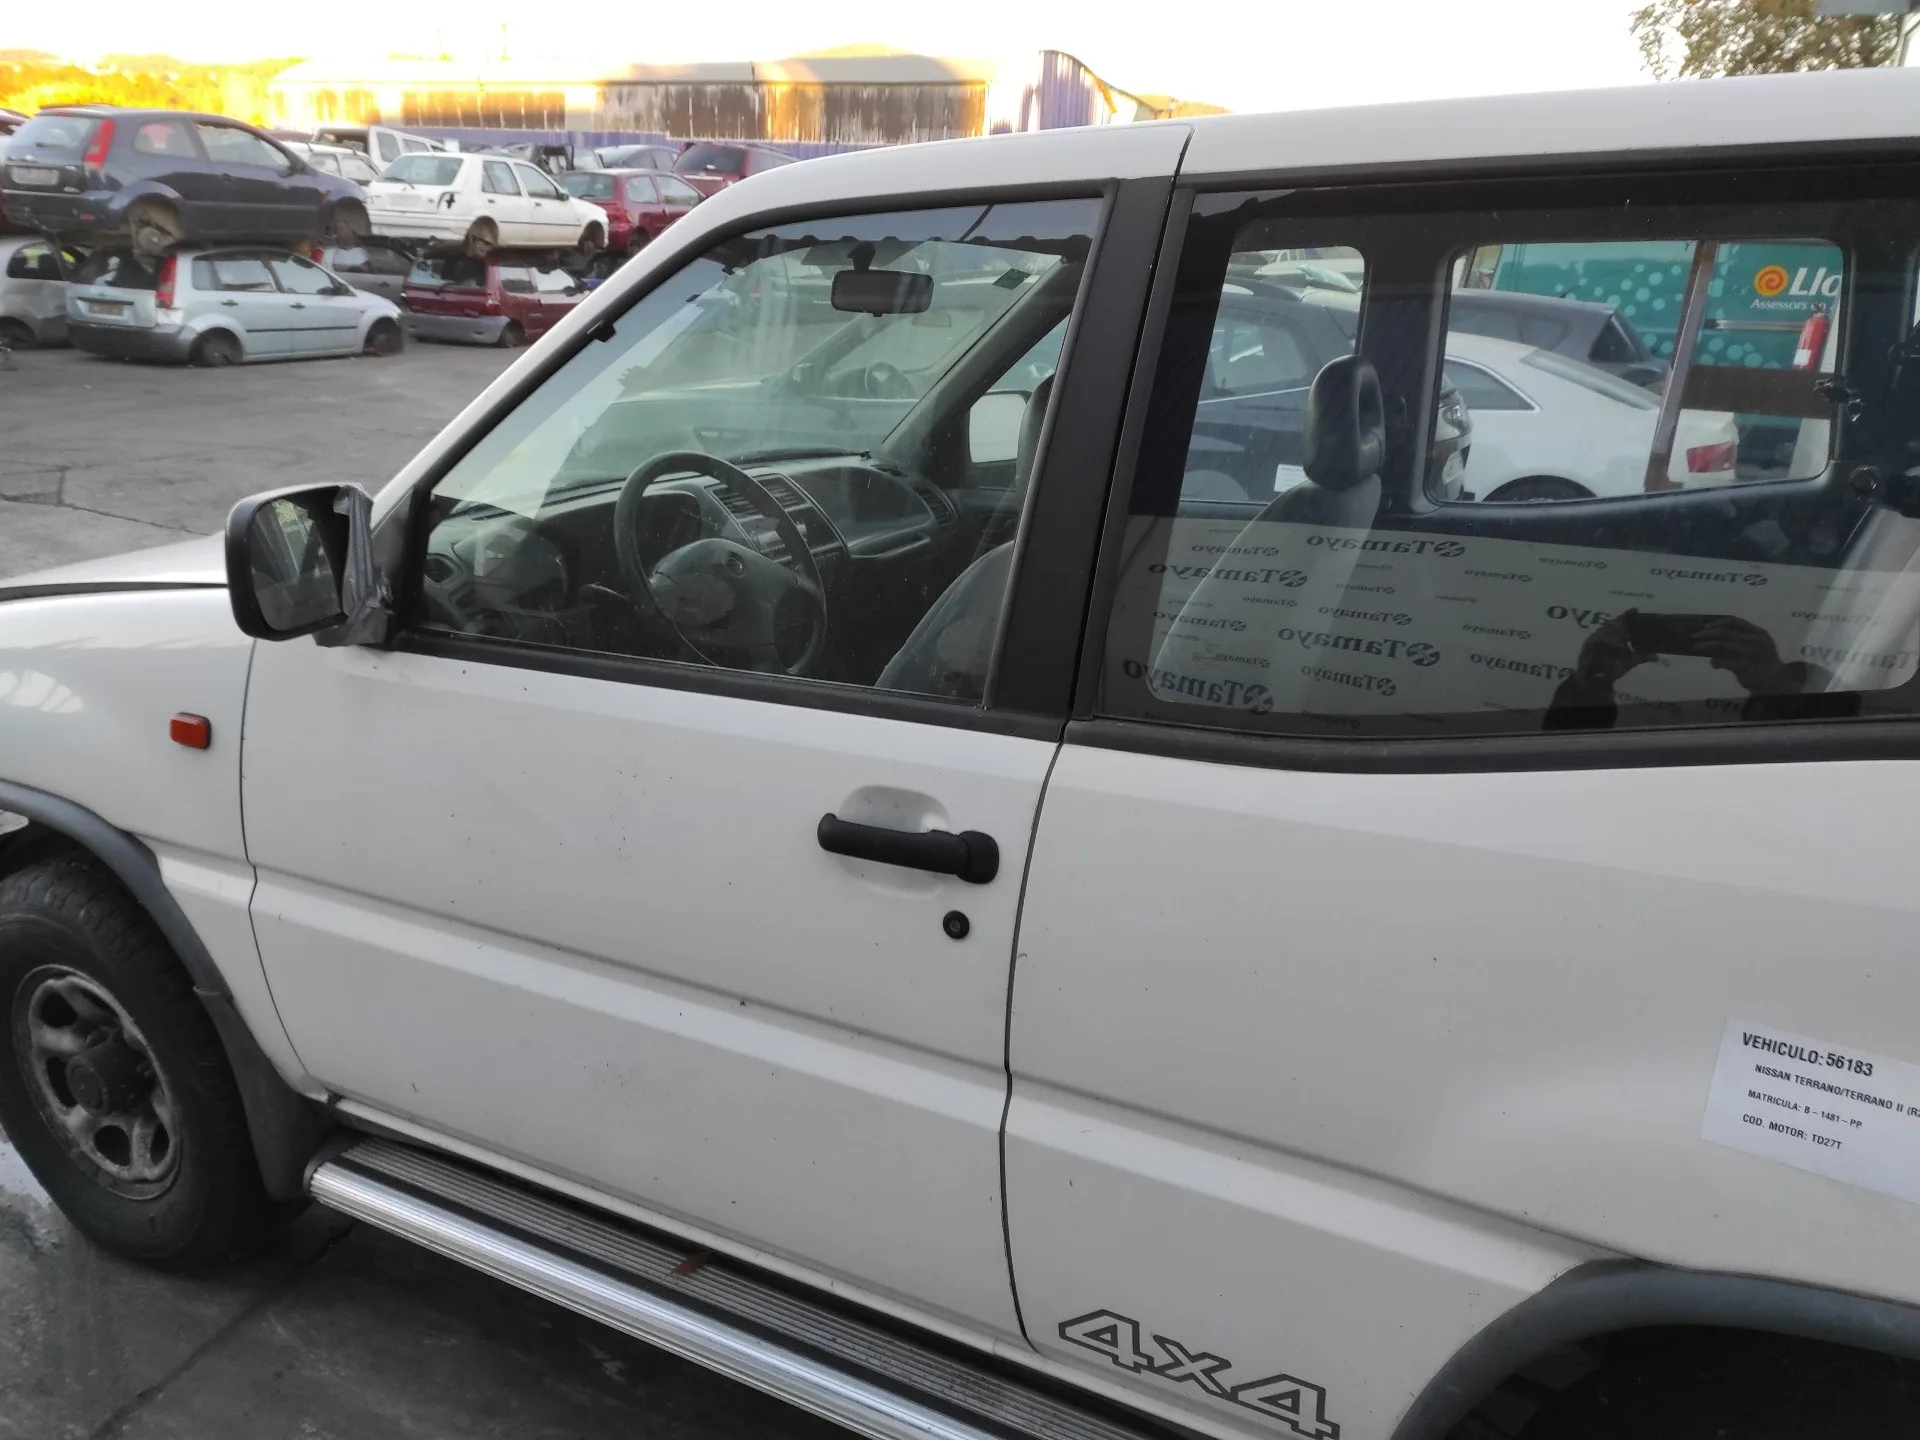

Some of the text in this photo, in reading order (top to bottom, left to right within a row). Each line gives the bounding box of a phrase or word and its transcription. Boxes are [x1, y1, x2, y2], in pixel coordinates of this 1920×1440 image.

[1751, 298, 1807, 310] Assessors
[1747, 1089, 1802, 1112] MATRICULA:
[1754, 1064, 1791, 1082] NISSAN
[1794, 1075, 1893, 1110] TERRANO/TERRANO
[1742, 1113, 1843, 1150] COD. MOTOR: TD27T
